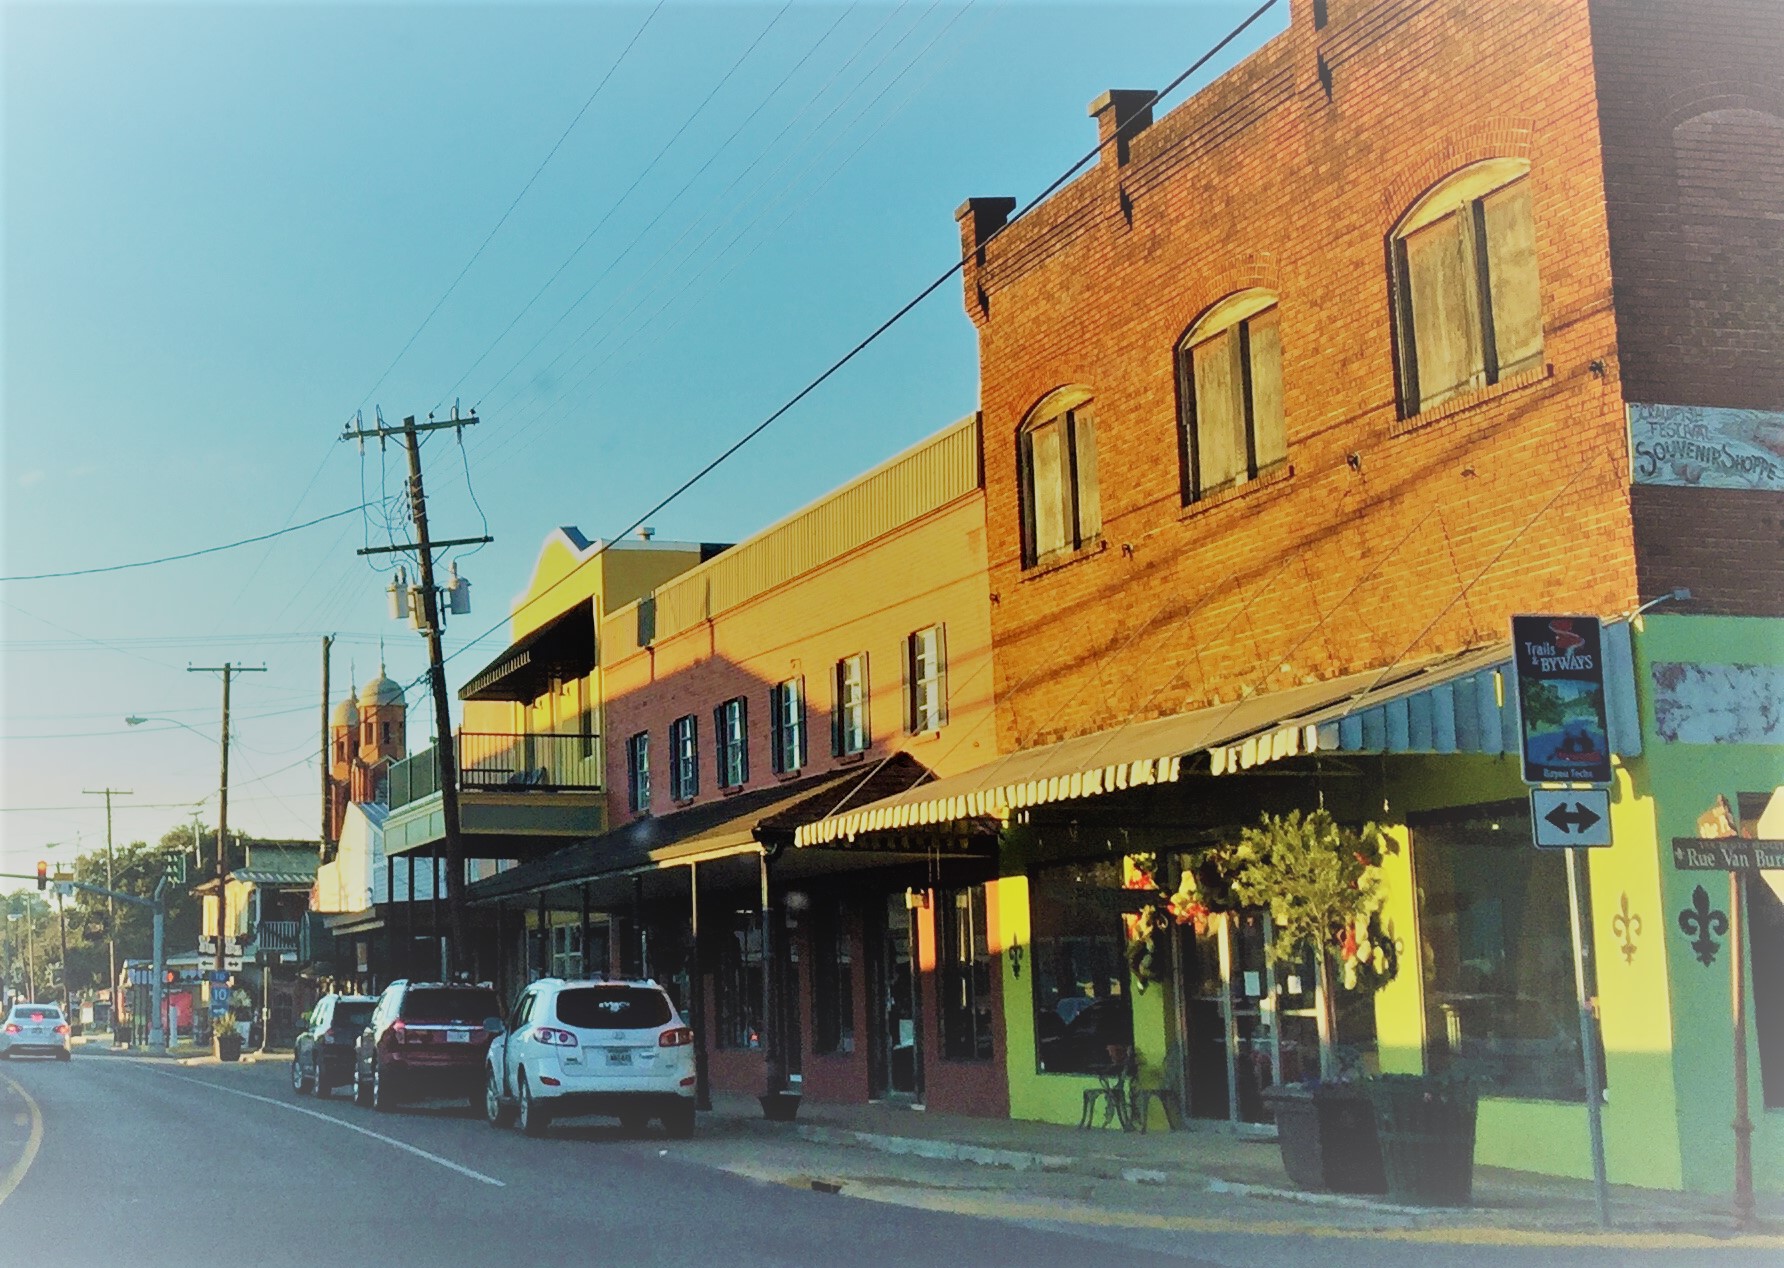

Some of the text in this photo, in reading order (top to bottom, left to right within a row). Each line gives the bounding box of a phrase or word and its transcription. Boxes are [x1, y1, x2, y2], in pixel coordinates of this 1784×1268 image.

[1635, 441, 1778, 481] SOUVENIR SHOPPE
[1525, 641, 1556, 656] Trails
[1540, 654, 1594, 673] BYWAYS
[1686, 848, 1716, 867] Rue
[1721, 848, 1750, 867] Van
[214, 988, 227, 1001] 10
